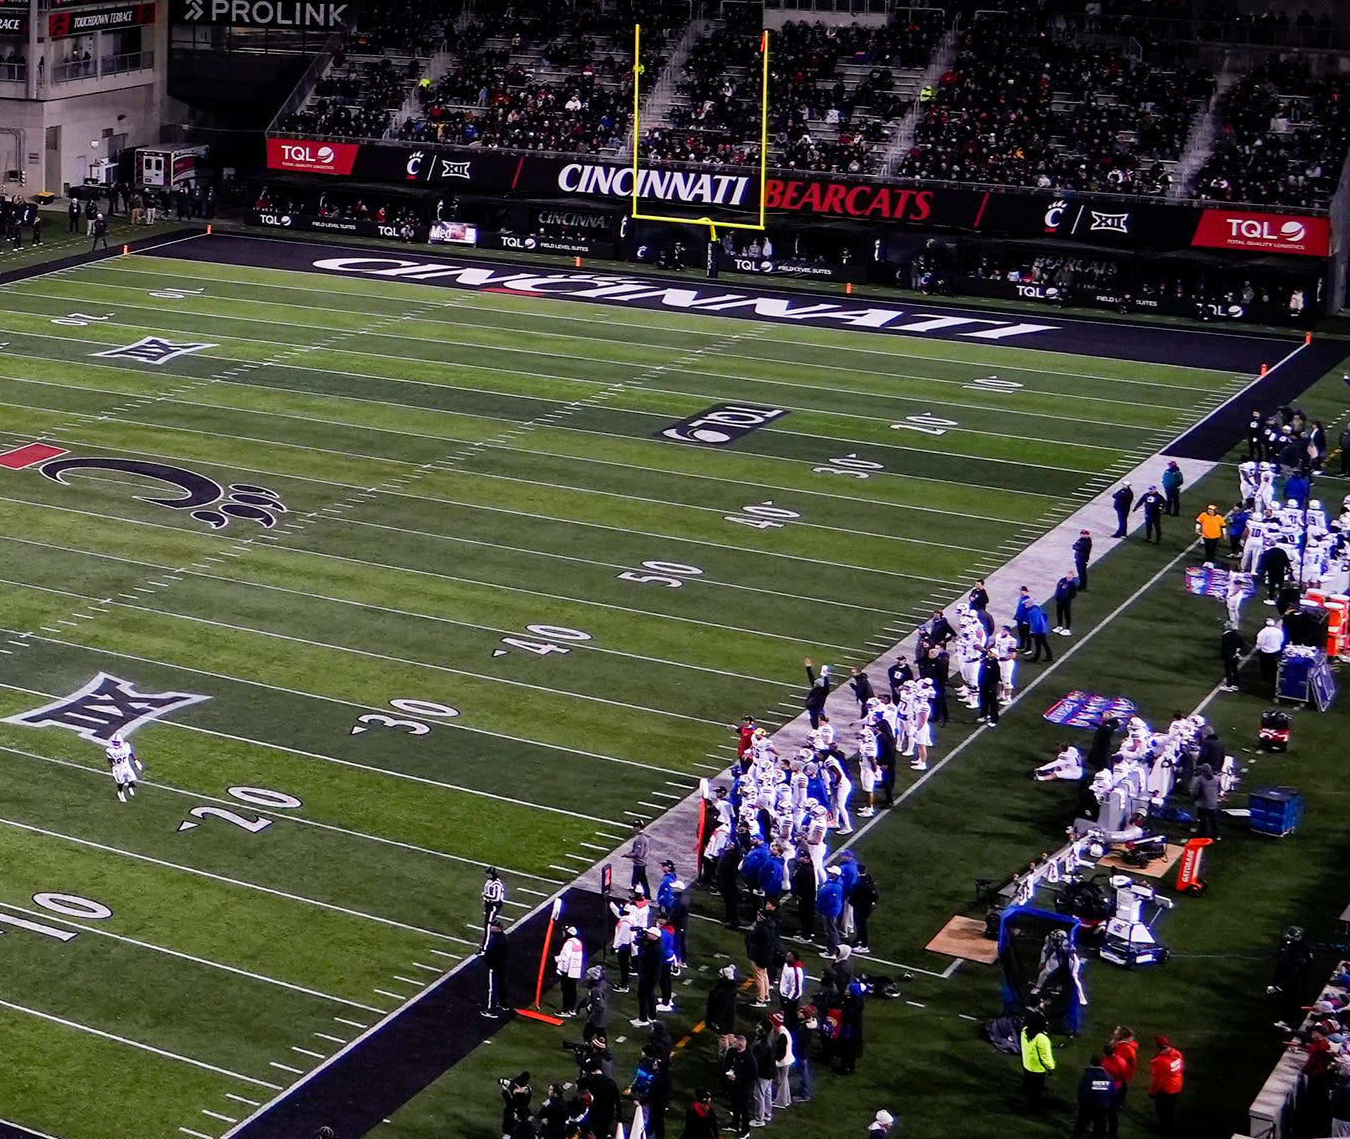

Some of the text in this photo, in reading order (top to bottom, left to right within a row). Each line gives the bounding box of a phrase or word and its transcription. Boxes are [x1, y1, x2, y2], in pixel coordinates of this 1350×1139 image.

[74, 11, 133, 28] TOUCHDOWN TERRACE
[281, 145, 316, 162] TQL
[558, 163, 749, 205] CINCINNATI
[765, 181, 933, 220] BEARCATS
[260, 214, 281, 226] TQL
[378, 225, 399, 237] TQL
[1226, 218, 1277, 240] TQL
[501, 236, 524, 249] TQL
[540, 242, 589, 252] FIELD LEVEL SUITES
[735, 259, 758, 272] TQL
[810, 267, 832, 275] SUITES
[312, 256, 1062, 340] CINCINNATI
[1016, 286, 1045, 299] TQL
[1096, 295, 1114, 303] FIELD
[1135, 299, 1158, 307] SUITES
[962, 378, 1024, 394] 10
[689, 406, 786, 429] TQL
[889, 415, 959, 437] 20
[812, 457, 885, 479] 30
[722, 505, 802, 530] 40
[616, 560, 704, 589] 50
[506, 623, 593, 657] 40
[356, 698, 460, 737] 30
[188, 786, 302, 834] 20
[1182, 849, 1195, 883] GATORADE
